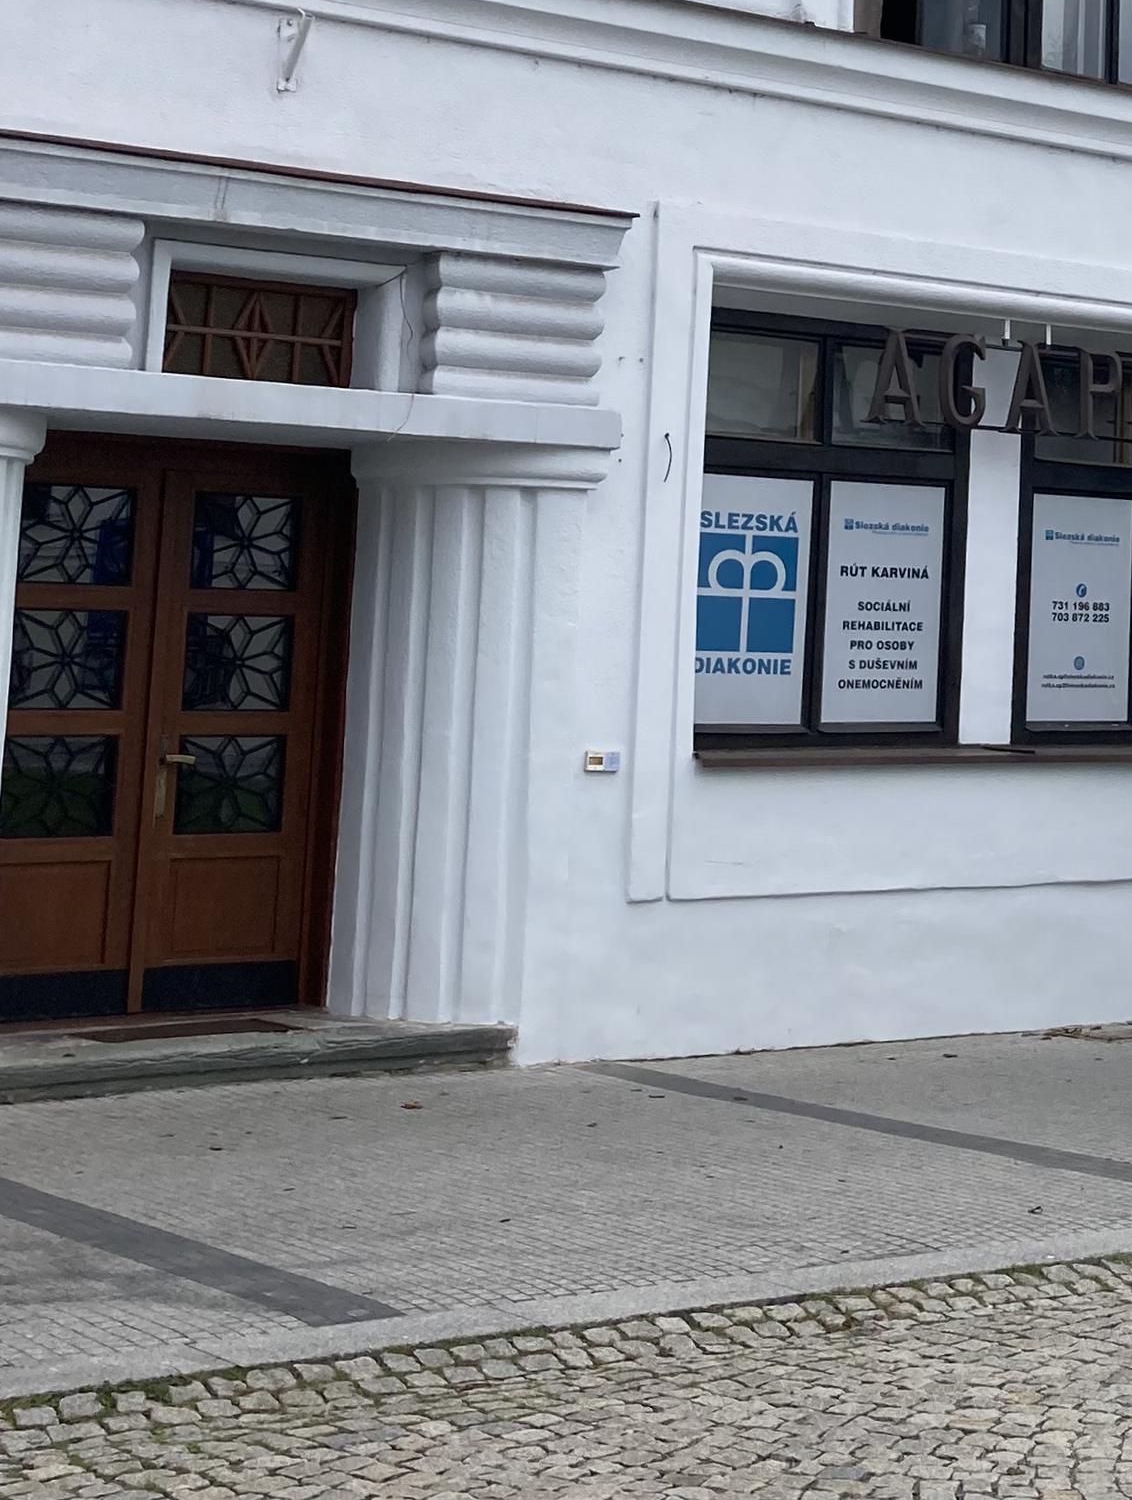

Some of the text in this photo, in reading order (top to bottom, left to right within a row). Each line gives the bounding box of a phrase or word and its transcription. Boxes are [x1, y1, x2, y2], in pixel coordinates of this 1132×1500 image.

[700, 510, 799, 534] SLEZSKÁ
[840, 563, 929, 580] RÚT KARVINÁ
[857, 599, 911, 612] SOCIÁLNÍ
[1052, 601, 1069, 610] 731
[1073, 601, 1090, 611] 196
[1052, 612, 1069, 622] 703
[1092, 614, 1110, 623] 225
[842, 620, 924, 631] REHABILITACE
[850, 640, 915, 651] PRO OSOBY
[694, 657, 792, 676] DIAKONIE
[848, 657, 918, 670] S DUŠEVNÍM
[838, 677, 923, 689] ONEMOCNĚNÍM
